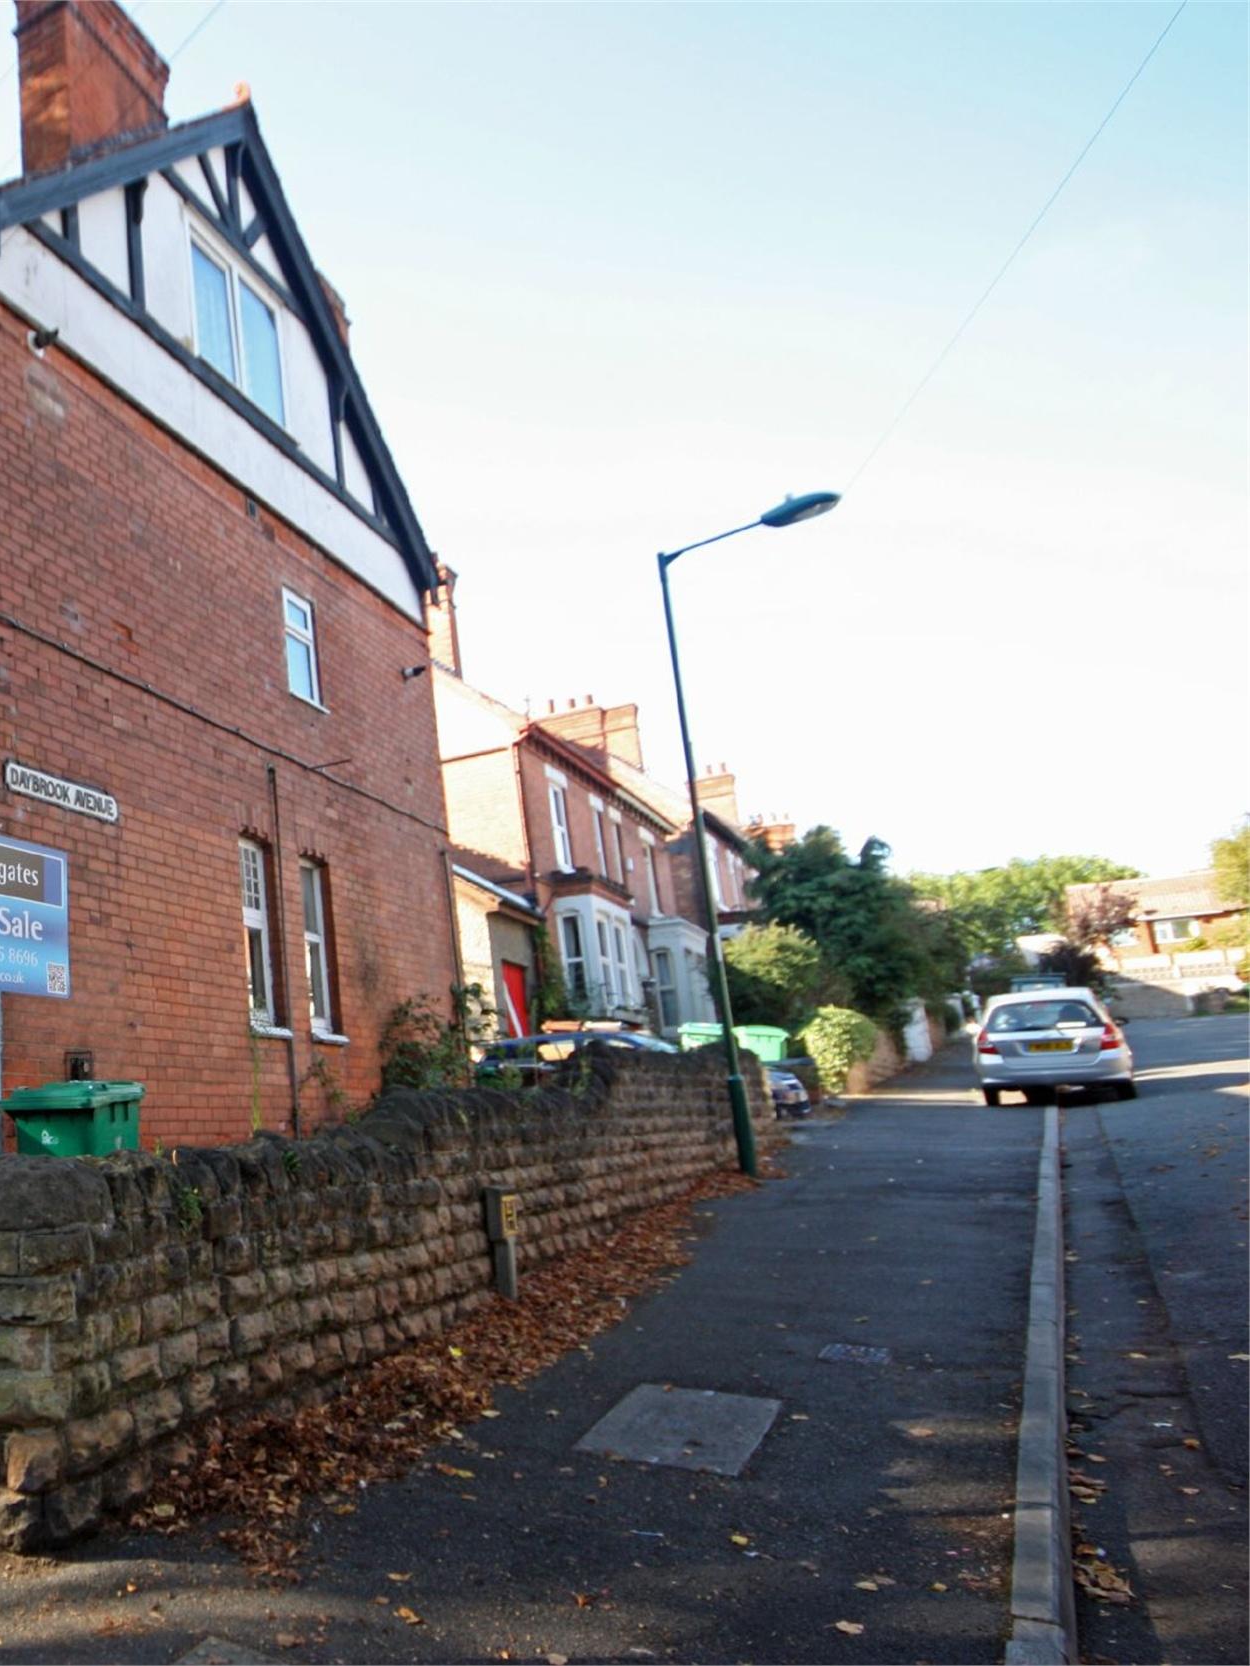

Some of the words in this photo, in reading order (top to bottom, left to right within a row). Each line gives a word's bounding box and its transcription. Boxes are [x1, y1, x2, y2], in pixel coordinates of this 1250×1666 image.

[10, 768, 71, 801] DAYBROOK
[74, 789, 115, 816] AVENUE
[8, 948, 39, 967] 8696
